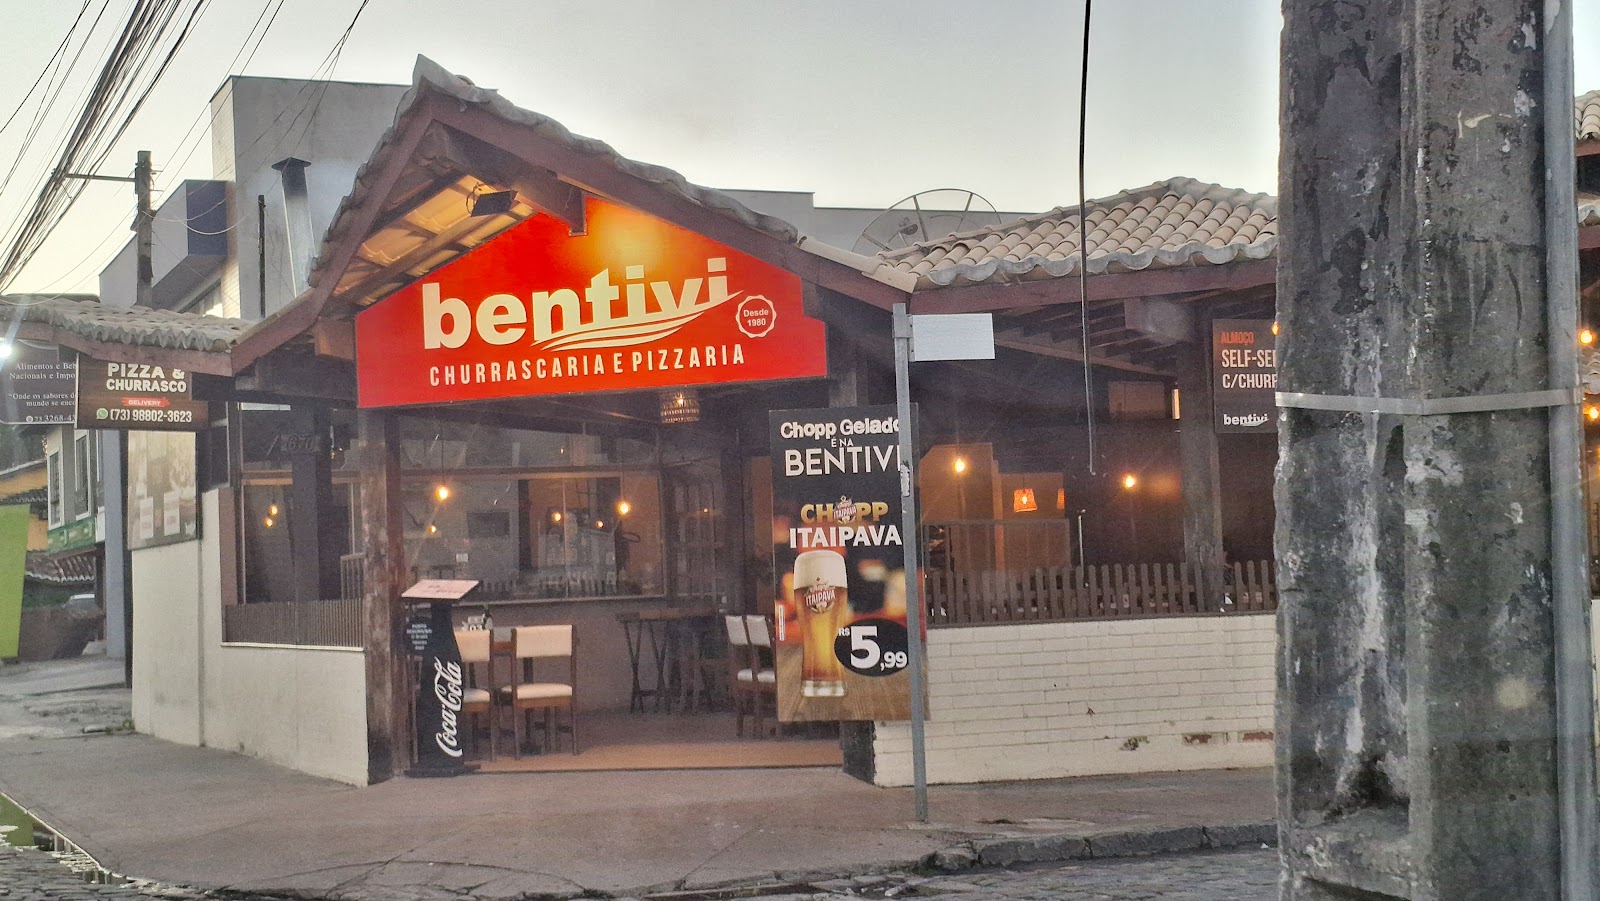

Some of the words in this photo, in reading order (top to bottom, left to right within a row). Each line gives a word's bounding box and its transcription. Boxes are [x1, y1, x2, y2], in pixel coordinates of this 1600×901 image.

[422, 257, 730, 349] bentivi
[743, 309, 769, 317] Desde
[747, 318, 766, 327] 1980
[1221, 331, 1255, 346] ALMOÇO
[107, 362, 166, 379] PIZZA
[171, 369, 185, 380] &
[429, 351, 605, 387] CHURRASCARIA
[613, 352, 623, 374] E
[632, 343, 746, 372] PIZZARIA
[9, 372, 47, 380] Nacionais
[106, 378, 187, 393] CHURRASCO
[128, 399, 162, 407] DELIVERY
[110, 408, 130, 421] (73)
[132, 409, 193, 423] 98802-3623
[1223, 413, 1269, 425] bentivi
[780, 421, 837, 440] Chopp
[831, 436, 837, 447] É
[839, 437, 854, 447] NA
[789, 525, 902, 549] ITAIPAVA
[805, 589, 836, 606] ITAIPAVA
[850, 626, 908, 671] 5,99
